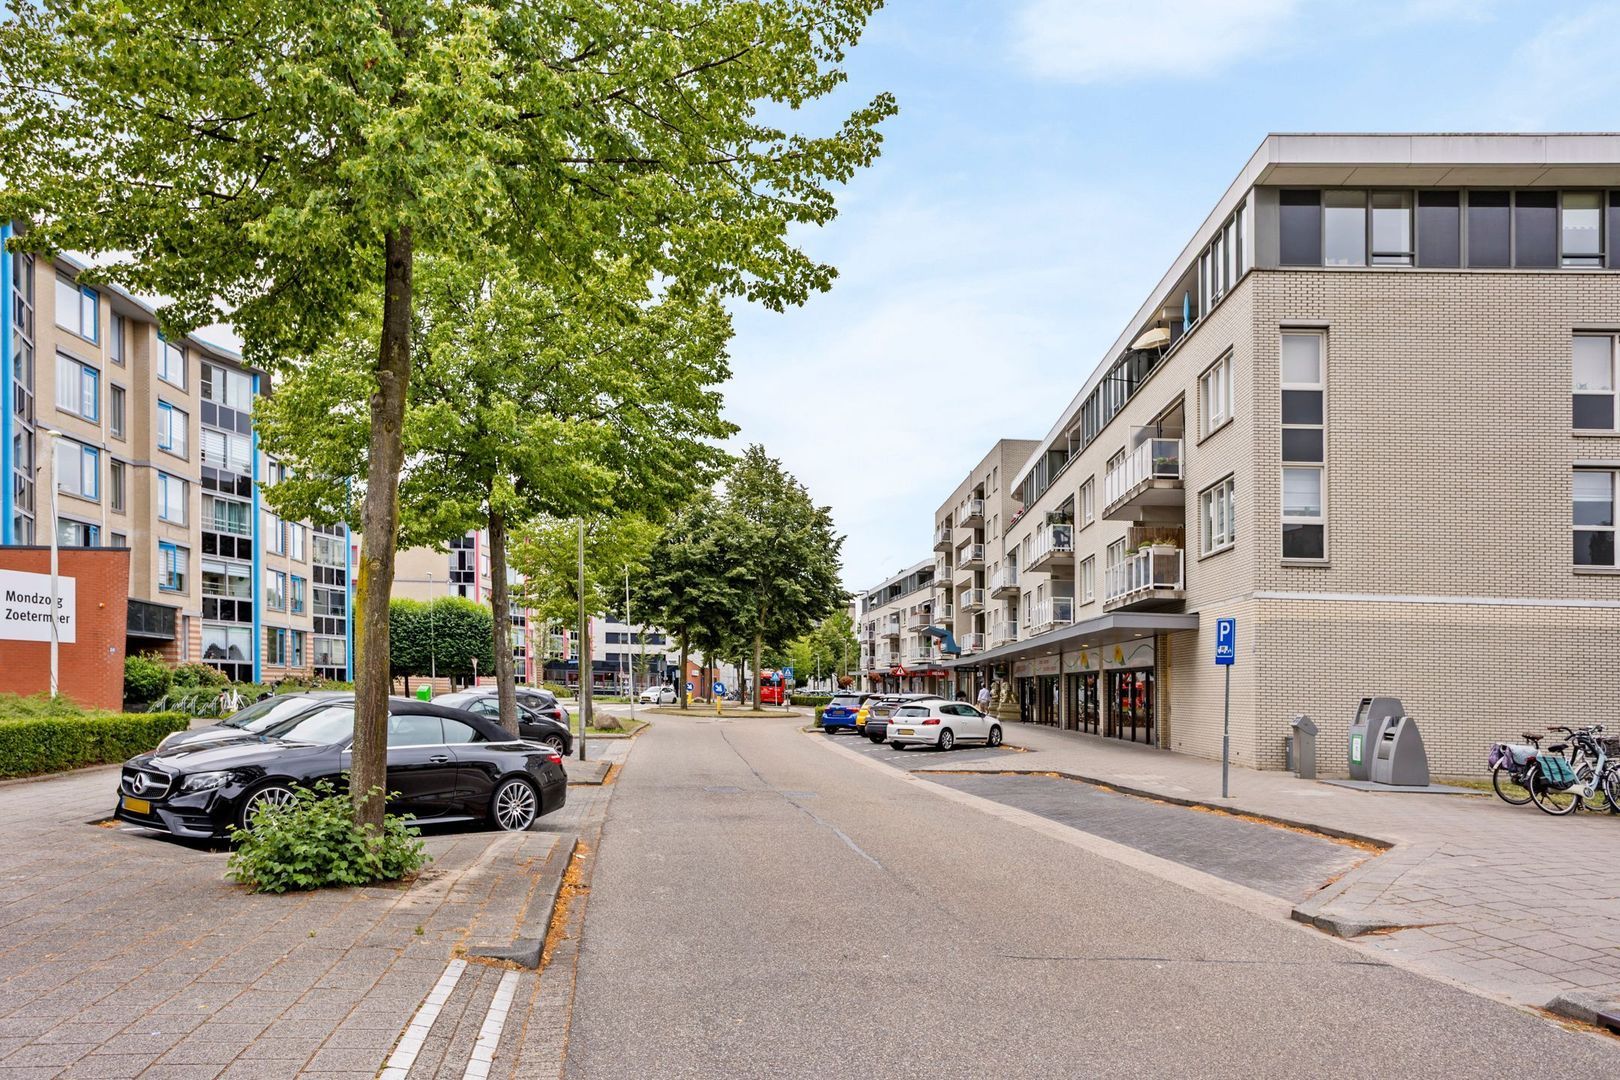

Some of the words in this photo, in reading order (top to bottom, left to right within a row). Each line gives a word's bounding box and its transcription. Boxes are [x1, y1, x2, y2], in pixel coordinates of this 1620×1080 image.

[5, 590, 63, 608] Mondzog
[5, 609, 70, 624] Zoetermer
[1220, 622, 1231, 641] P
